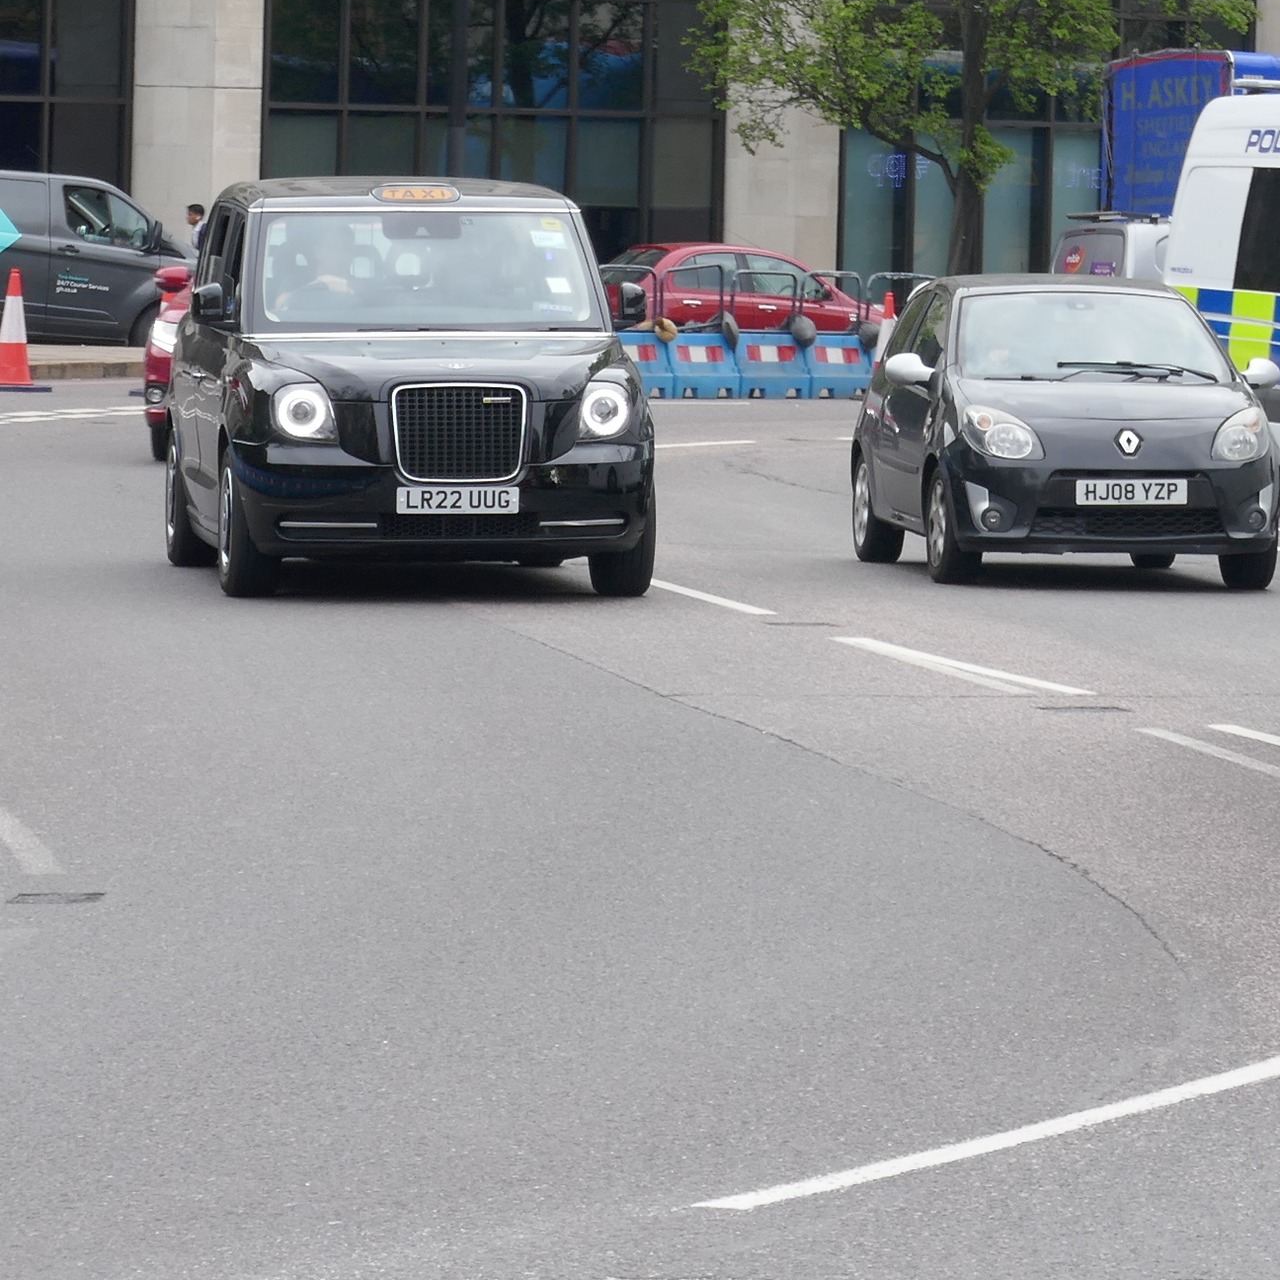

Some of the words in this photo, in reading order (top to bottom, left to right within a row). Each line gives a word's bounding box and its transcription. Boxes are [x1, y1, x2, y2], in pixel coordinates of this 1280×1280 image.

[1148, 74, 1213, 109] ASKEY
[389, 189, 446, 199] TAXI
[406, 490, 462, 509] LR22
[469, 490, 510, 509] UUG
[1085, 483, 1135, 501] HJ08
[1142, 483, 1178, 500] YZP
